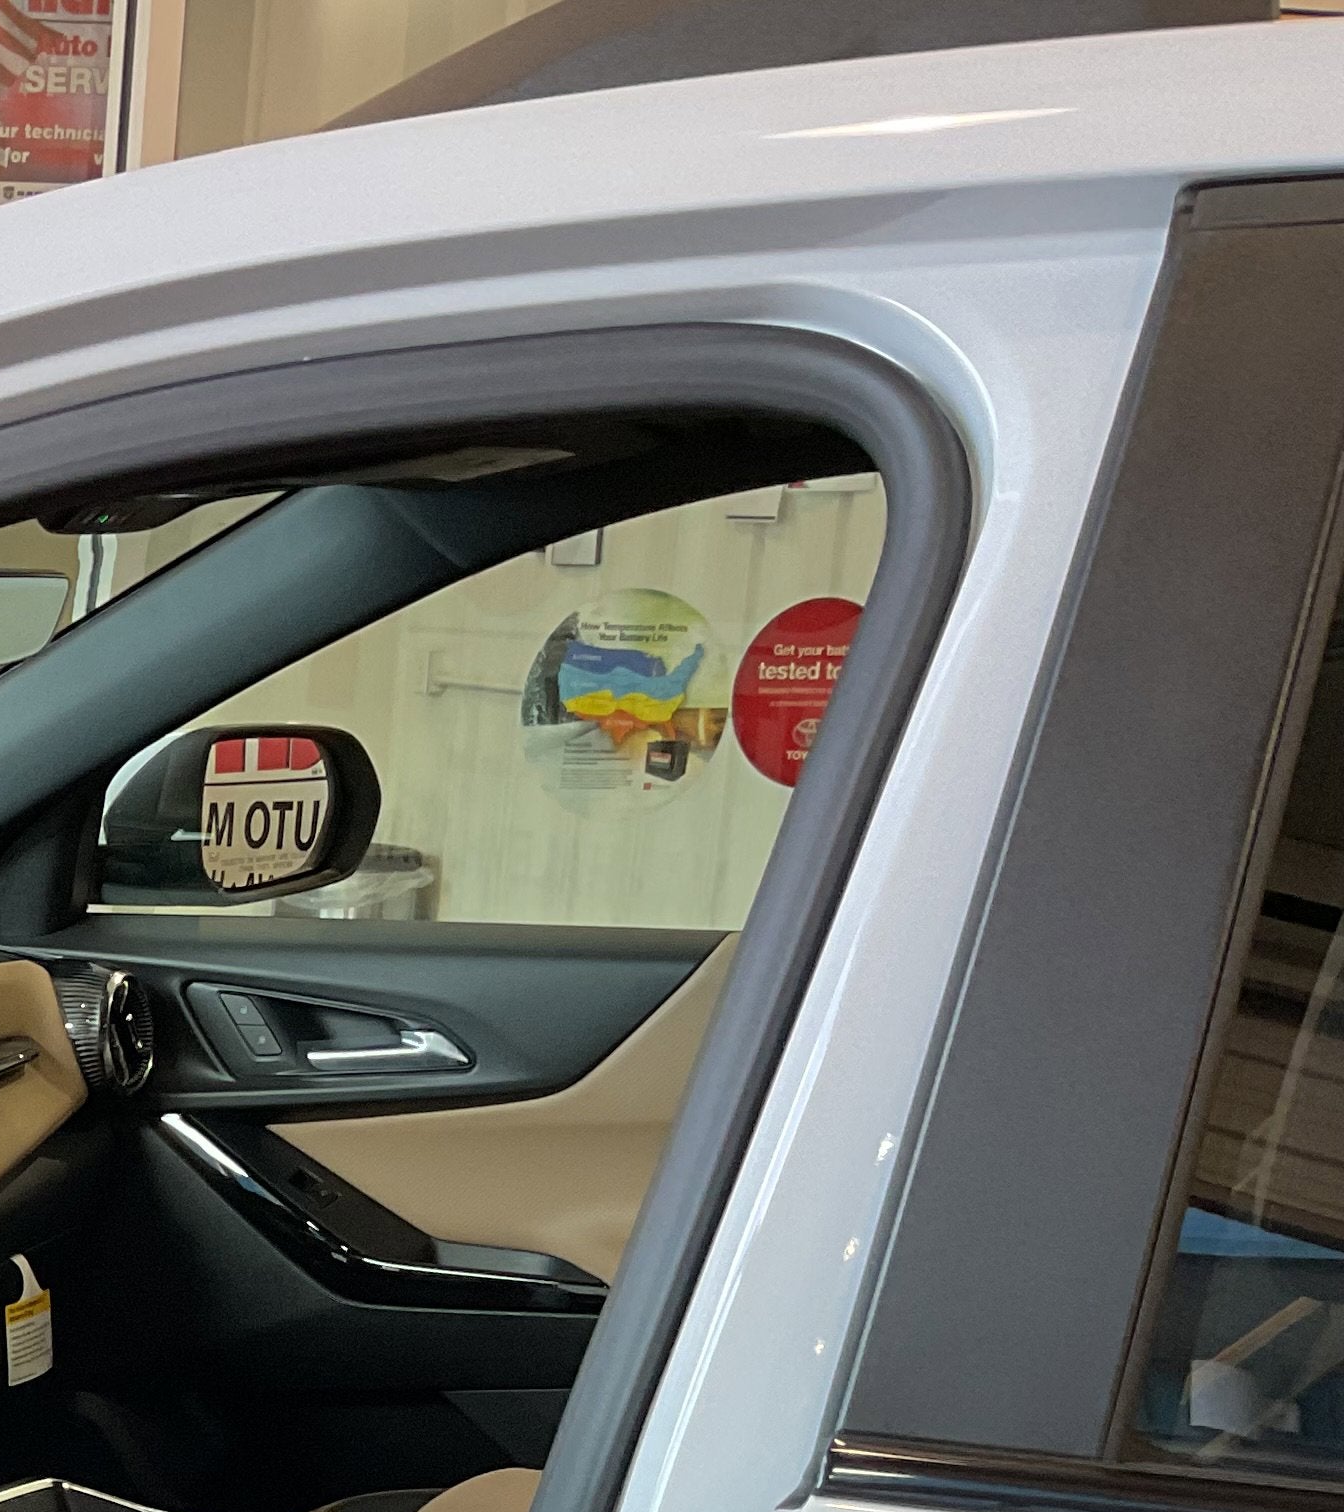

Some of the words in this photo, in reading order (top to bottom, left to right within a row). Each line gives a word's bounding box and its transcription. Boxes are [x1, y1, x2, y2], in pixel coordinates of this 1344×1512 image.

[4, 147, 30, 164] for
[774, 644, 795, 656] Get
[798, 646, 824, 659] your
[758, 662, 820, 680] tested
